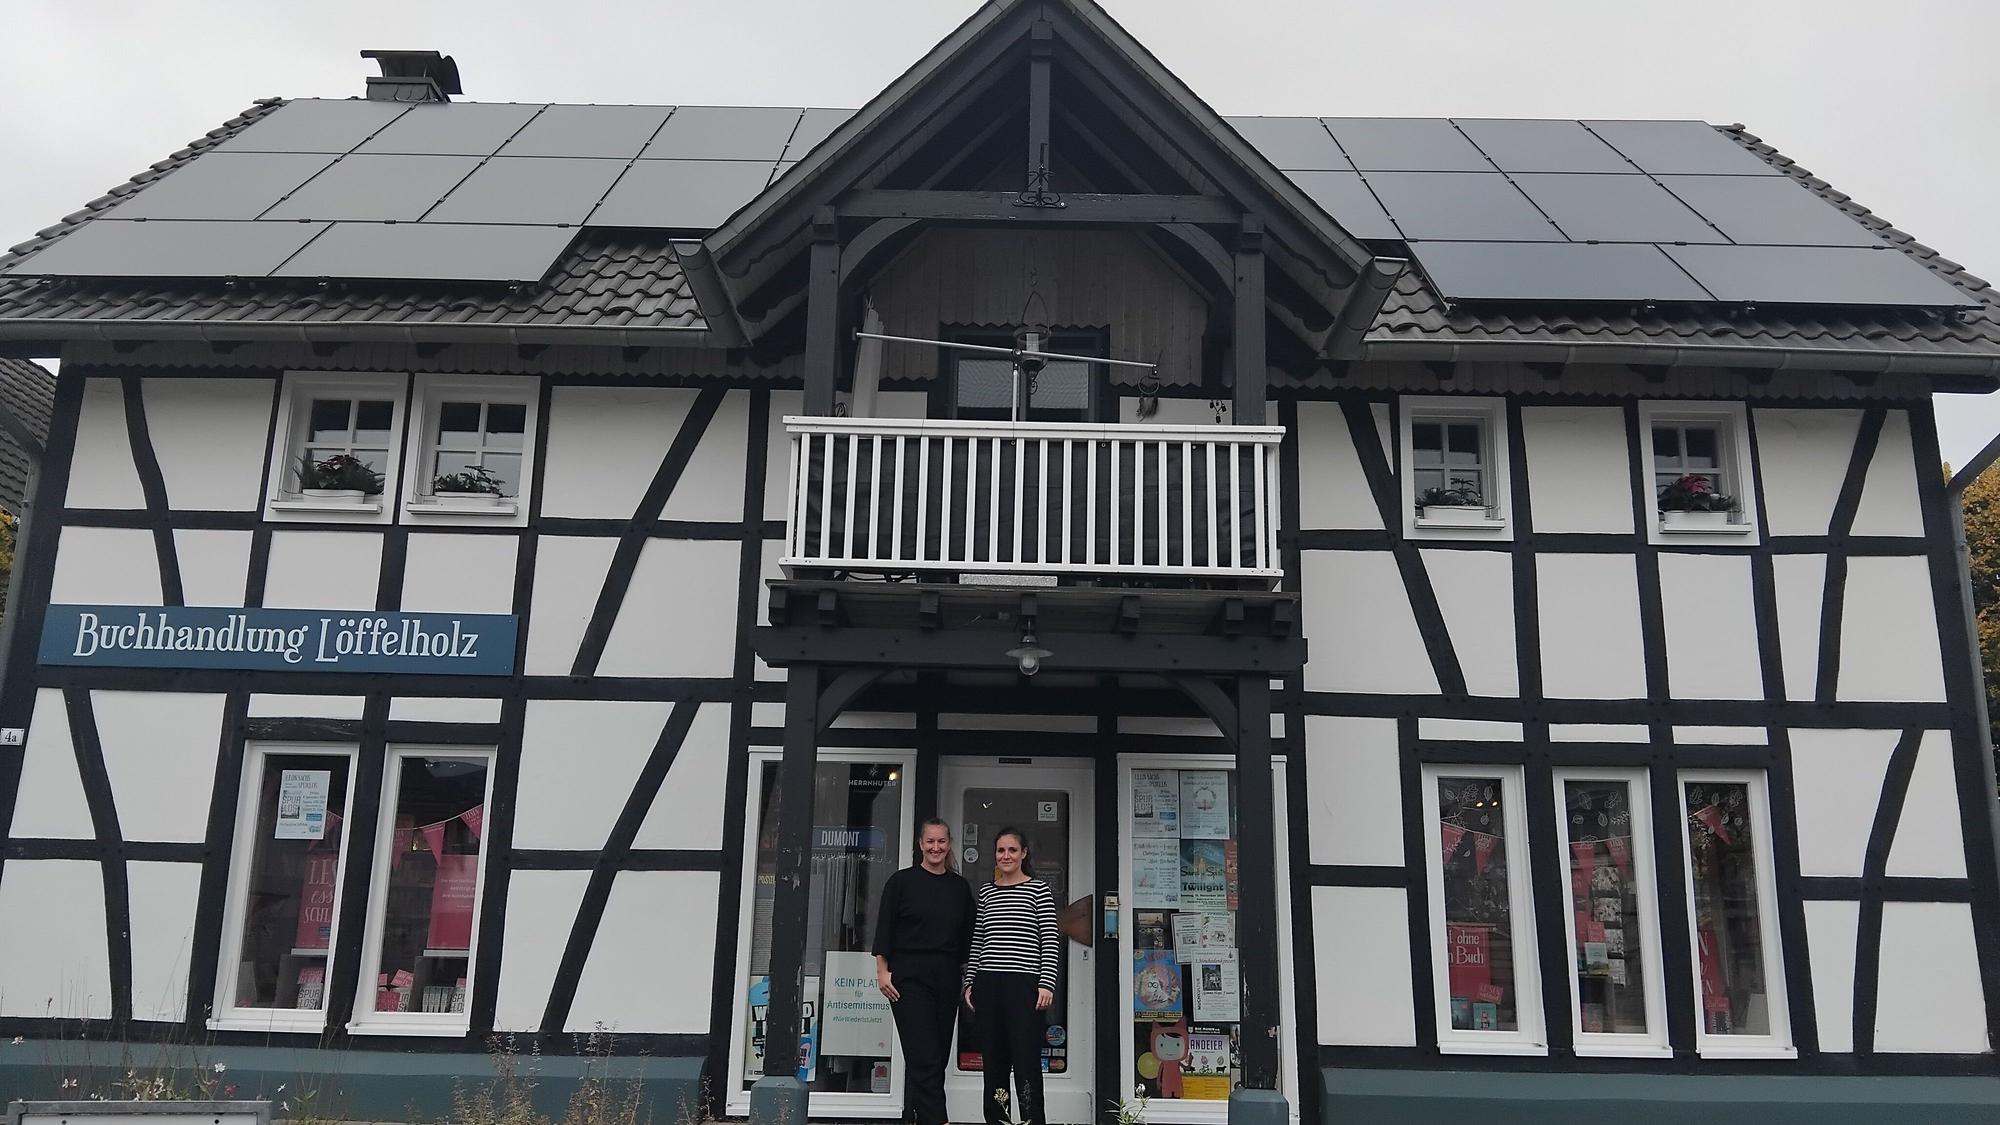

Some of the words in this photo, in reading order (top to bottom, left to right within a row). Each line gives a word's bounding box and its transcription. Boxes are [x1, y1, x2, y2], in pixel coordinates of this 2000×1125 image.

[73, 612, 309, 664] Buchhandlung
[315, 617, 479, 662] Löffelholz
[5, 731, 17, 743] 4a
[848, 779, 897, 787] HERRNHUTER
[821, 830, 860, 847] DUMONT
[308, 859, 338, 887] LES
[1457, 929, 1480, 945] ohne
[1456, 946, 1484, 965] Buch
[834, 977, 855, 988] KEIN
[857, 978, 879, 988] PLAT
[298, 989, 320, 999] SPUR
[827, 1000, 890, 1010] Antisemitismus
[1189, 1039, 1223, 1050] ANDEIER
